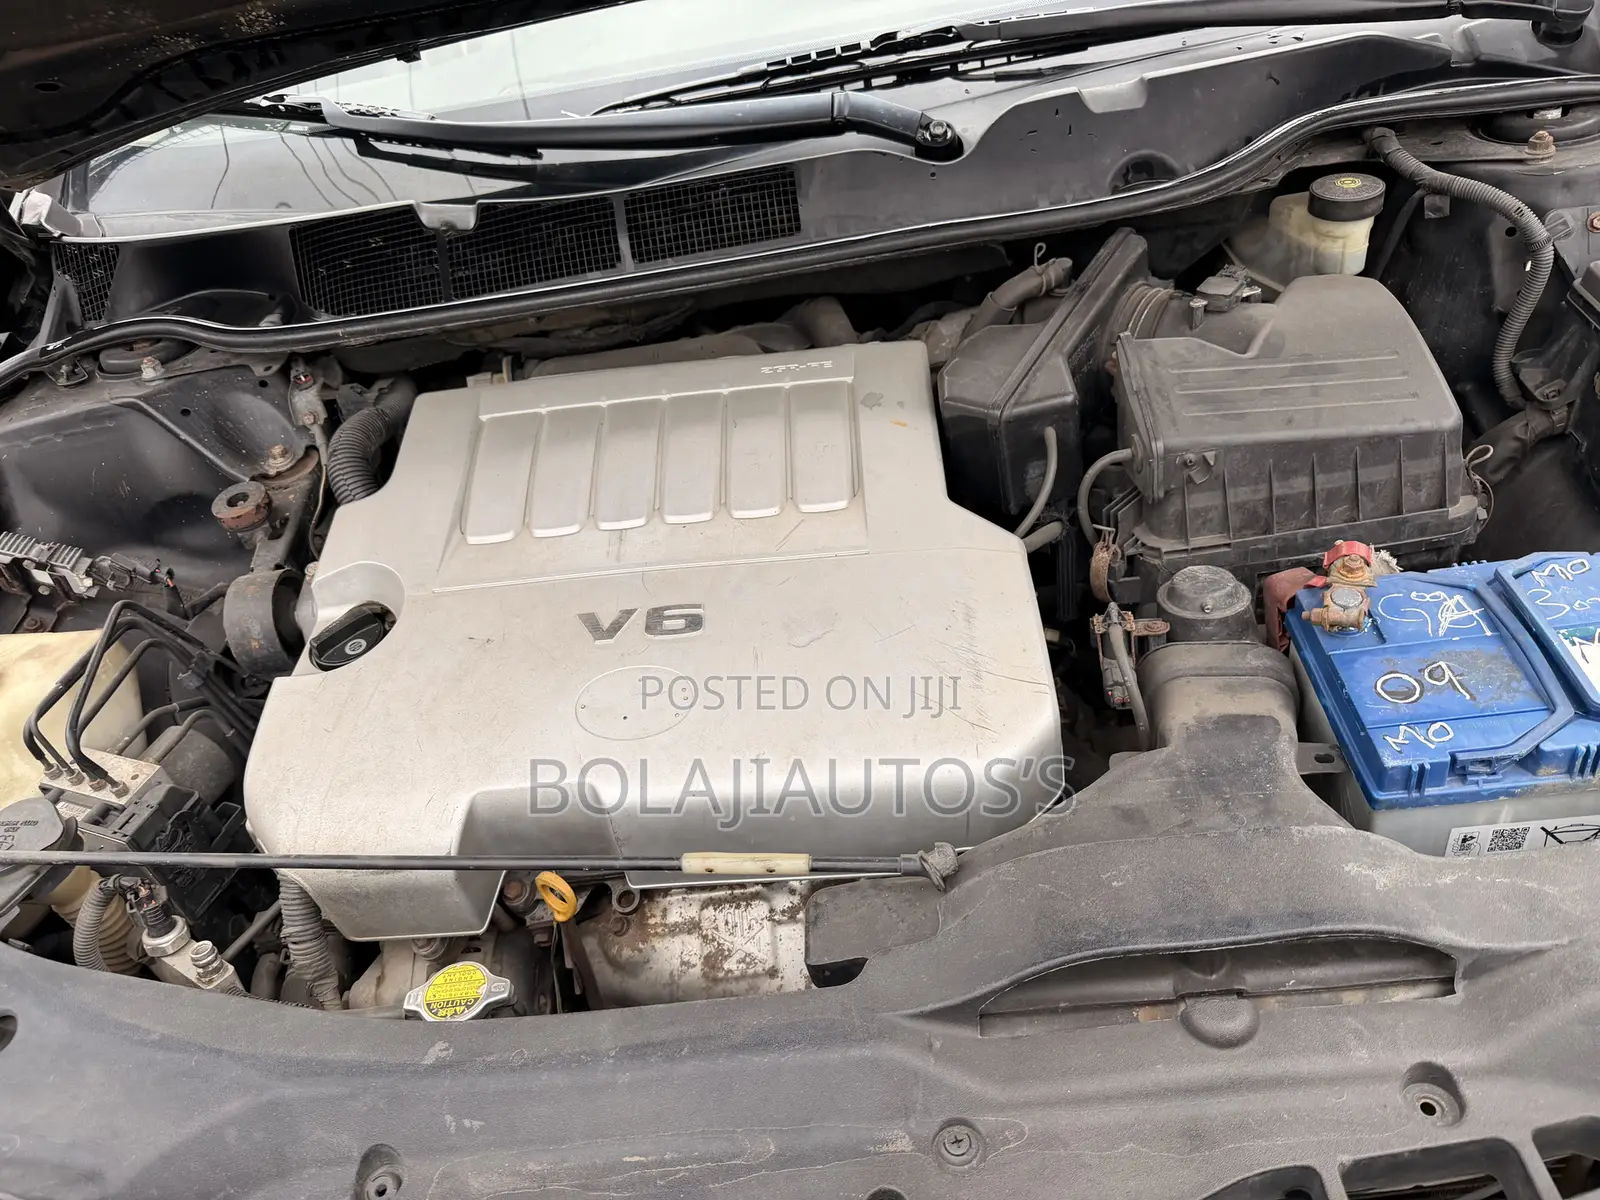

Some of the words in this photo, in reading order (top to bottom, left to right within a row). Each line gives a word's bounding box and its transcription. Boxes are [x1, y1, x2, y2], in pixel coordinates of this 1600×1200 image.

[576, 603, 706, 644] V6
[1376, 660, 1473, 704] 09
[430, 998, 475, 1008] CAUTION
